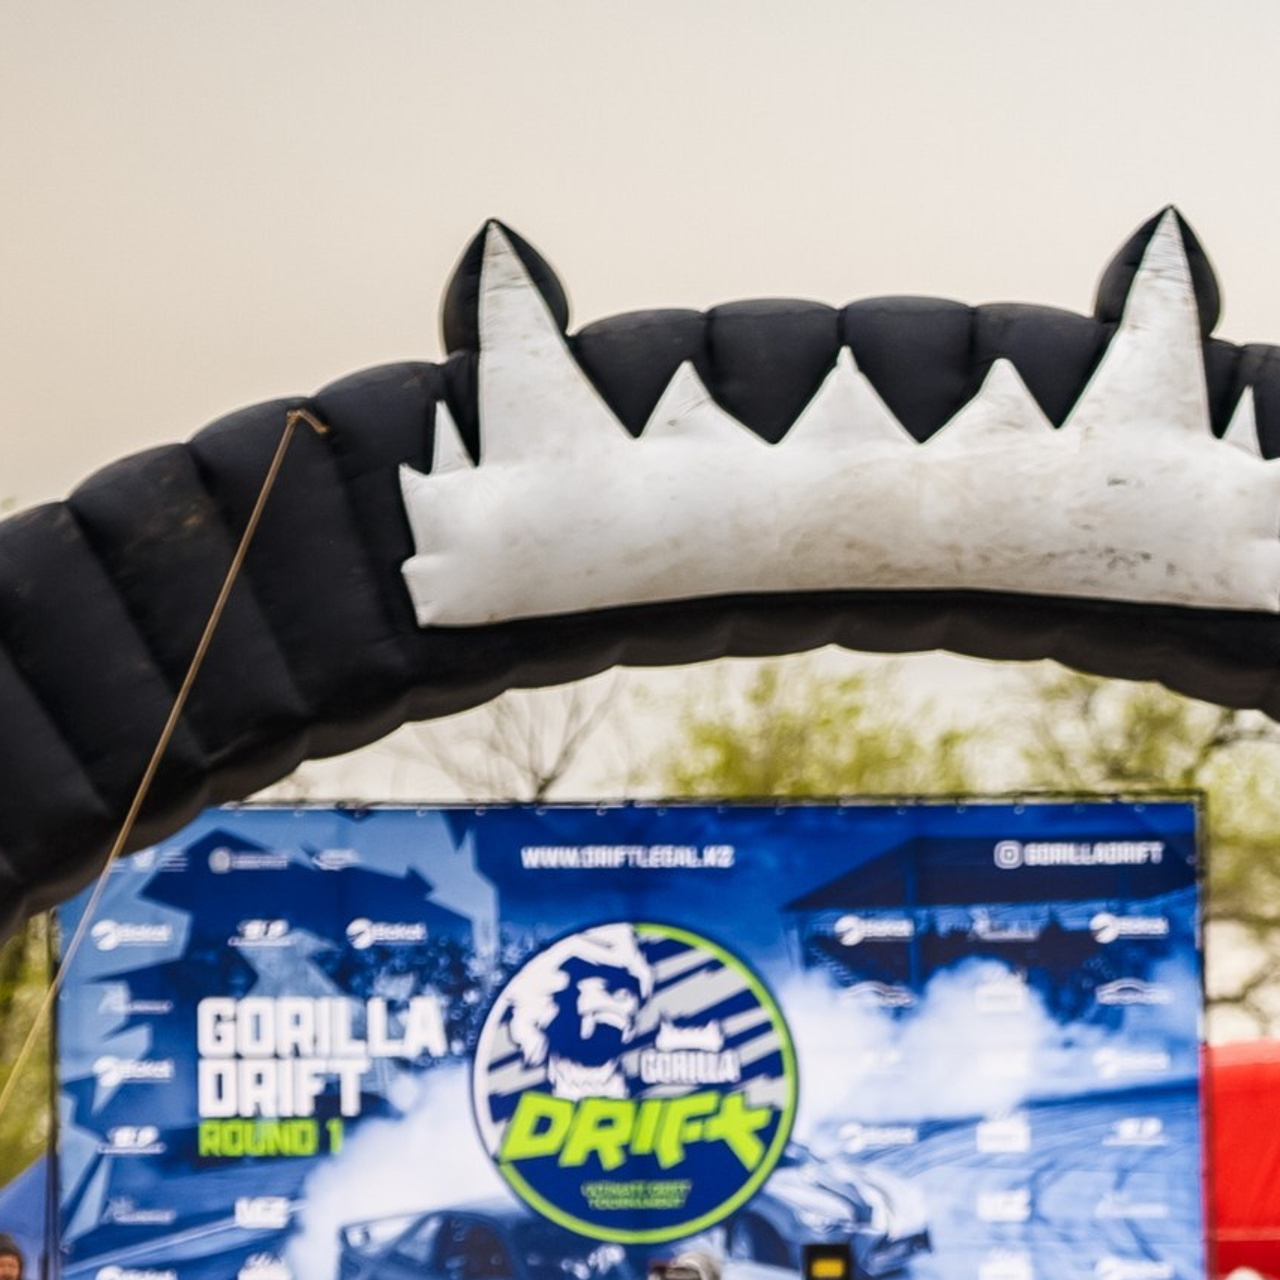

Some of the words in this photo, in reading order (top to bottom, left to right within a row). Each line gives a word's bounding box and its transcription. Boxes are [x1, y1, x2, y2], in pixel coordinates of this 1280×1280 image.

[197, 996, 447, 1058] GORILLA
[198, 1058, 370, 1118] DRIFT
[640, 1050, 741, 1083] GORILLA
[199, 1119, 318, 1157] ROUND
[326, 1118, 343, 1154] 1
